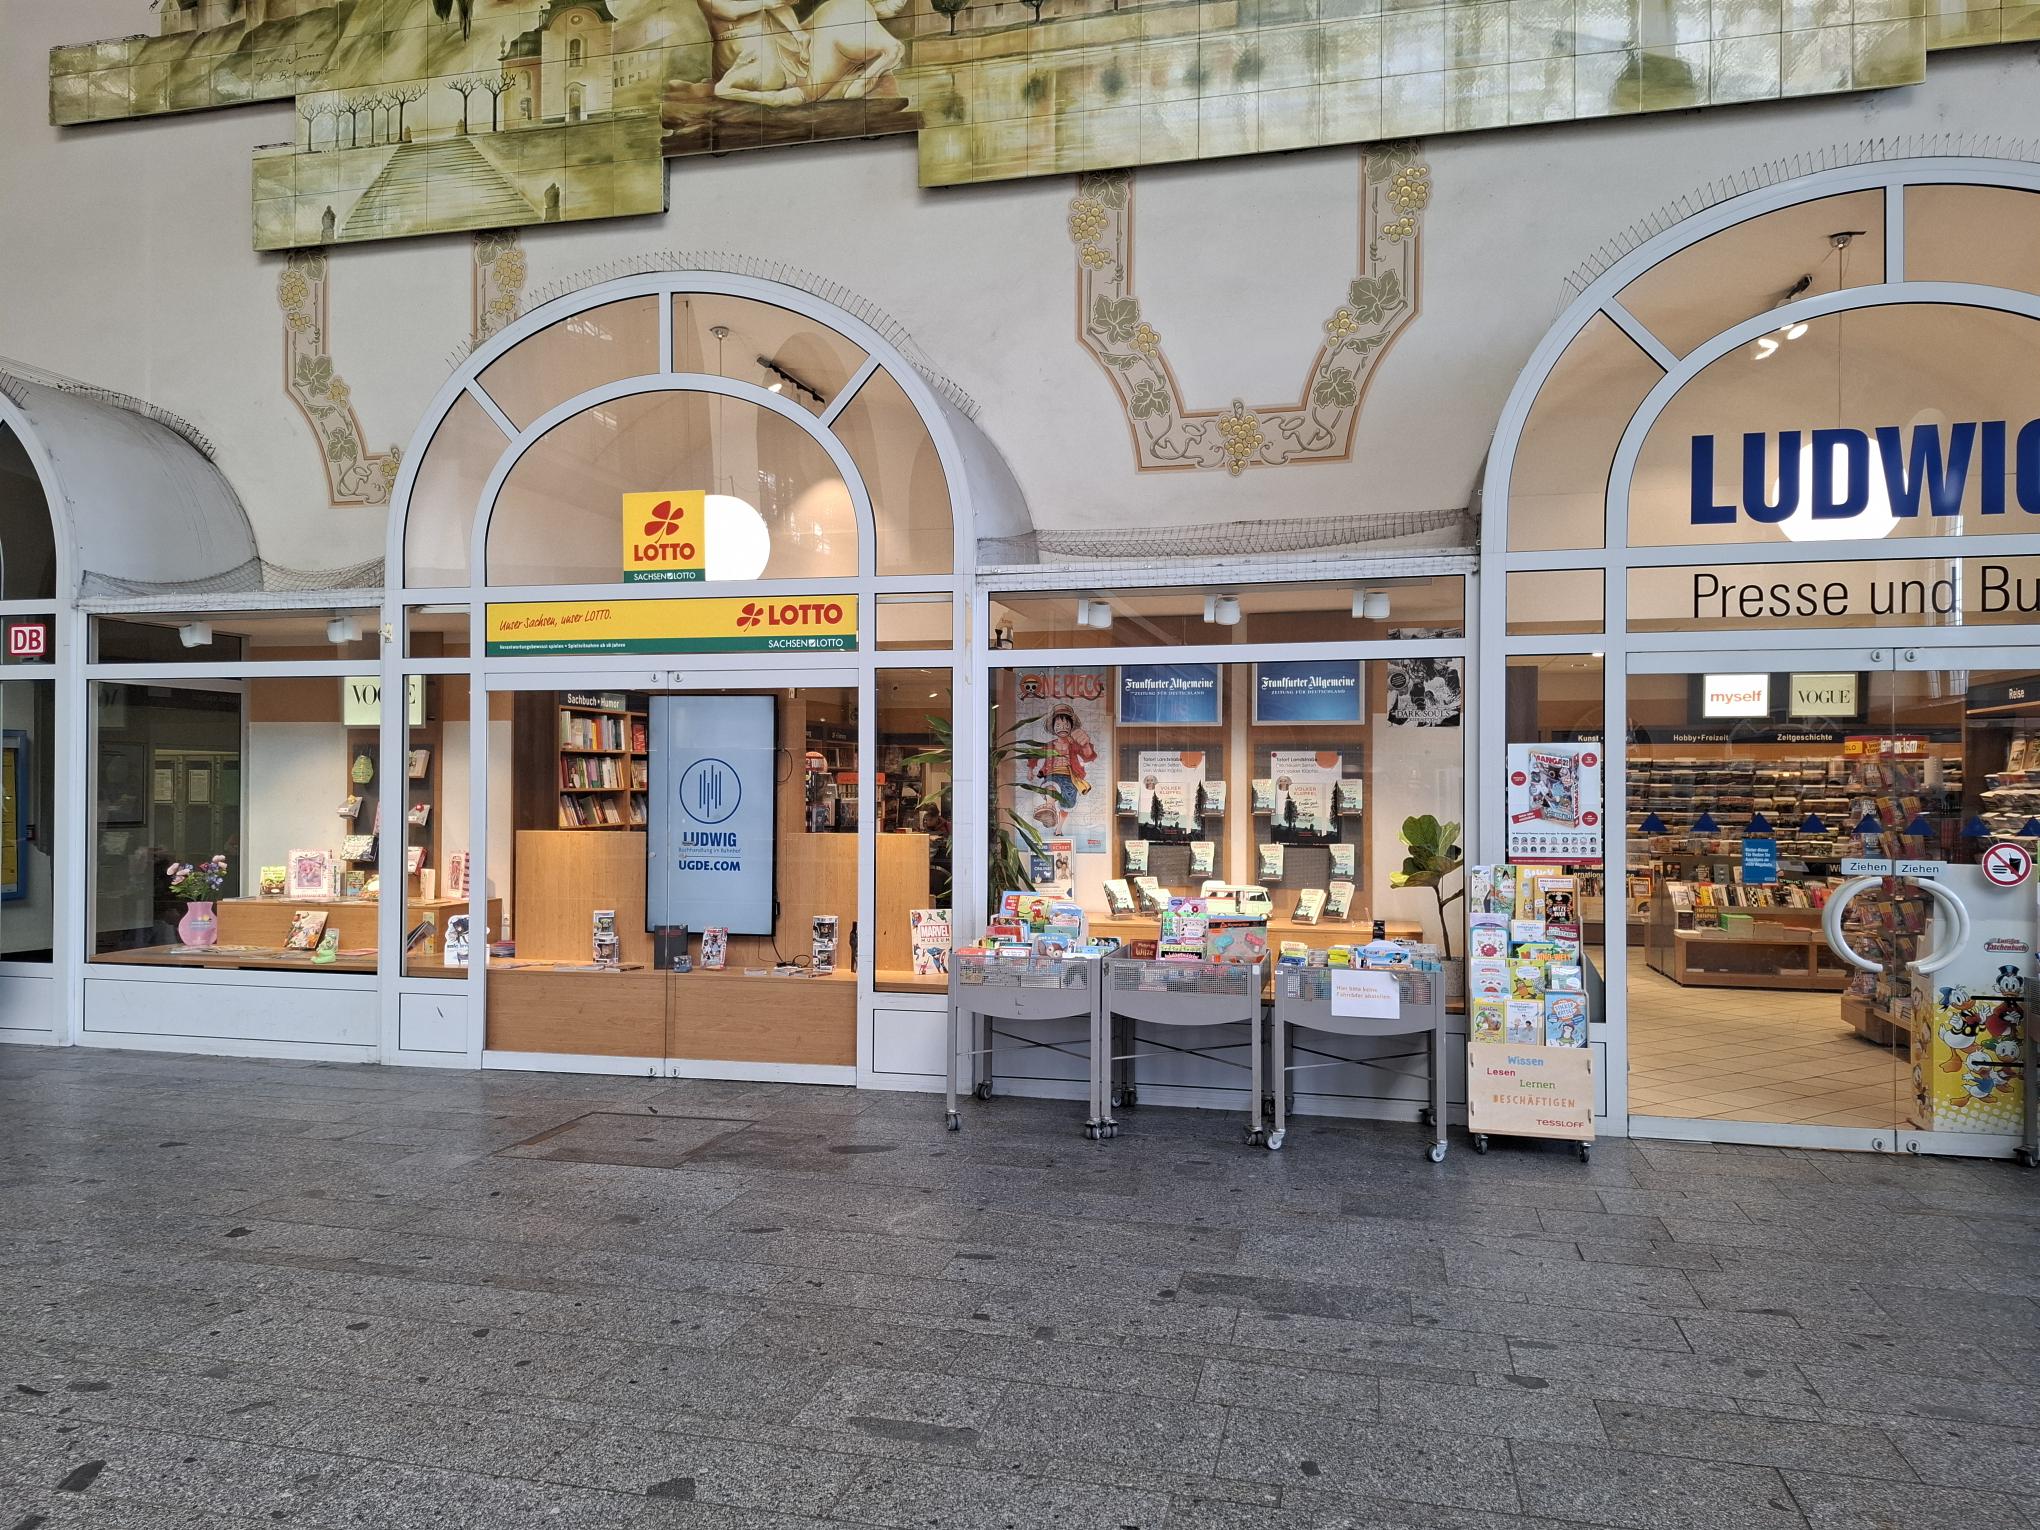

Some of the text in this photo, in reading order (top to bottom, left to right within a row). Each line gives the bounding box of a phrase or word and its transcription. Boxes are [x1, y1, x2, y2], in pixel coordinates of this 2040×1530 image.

[633, 542, 696, 561] LOTTO
[633, 571, 696, 581] SACHSEN LOTTO
[1693, 573, 1849, 618] Presse
[1870, 566, 1957, 615] und
[499, 608, 612, 631] Unser Sachsen, unser LOTTO.
[768, 603, 843, 625] LOTTO
[14, 629, 41, 651] DB
[768, 638, 844, 648] SACHSEN LOTTO
[1125, 677, 1214, 692] Frankfurter Allgemeine
[1261, 675, 1355, 691] Frankfurter Allgemeine
[1710, 689, 1762, 704] myself
[1797, 689, 1851, 705] VOGUE
[2008, 688, 2025, 700] Reise
[567, 693, 620, 709] Sachbuch Humor
[1396, 709, 1450, 718] DARK SOULS
[1673, 734, 1729, 743] Hobby Freizeit
[1776, 733, 1833, 743] Zeitgeschichte
[683, 831, 737, 847] LUDWIG
[678, 860, 741, 872] UGDE.COM
[1850, 862, 1888, 871] Ziehen
[1901, 864, 1939, 874] Ziehen
[920, 925, 950, 938] MARVEL
[1507, 1055, 1544, 1066] Wissen
[1486, 1067, 1516, 1077] Lesen
[1519, 1079, 1557, 1089] Lernen
[1492, 1094, 1576, 1108] BESCHÄFTIGEN
